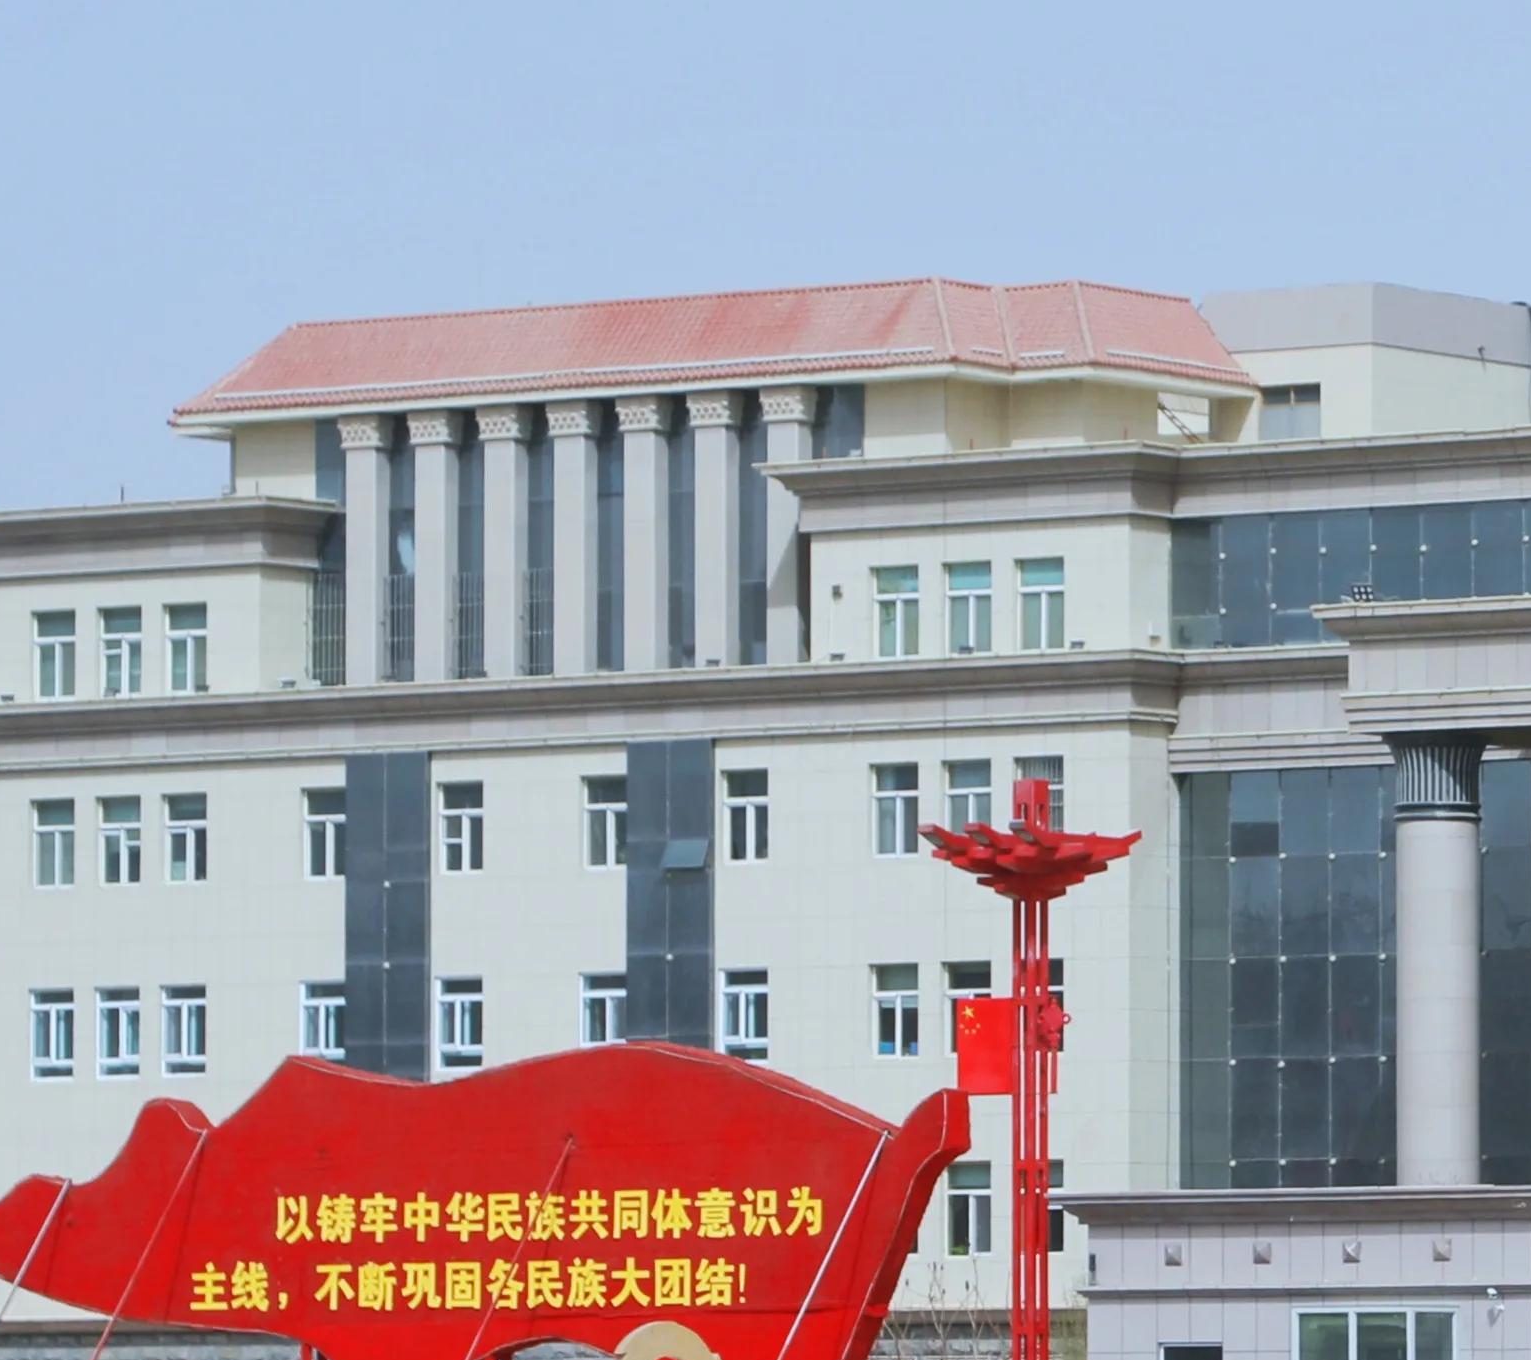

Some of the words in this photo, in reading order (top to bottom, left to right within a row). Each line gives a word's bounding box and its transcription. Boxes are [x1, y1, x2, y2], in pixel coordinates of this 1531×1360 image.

[275, 1184, 824, 1245] 以铸牢中华民族共同体意识为
